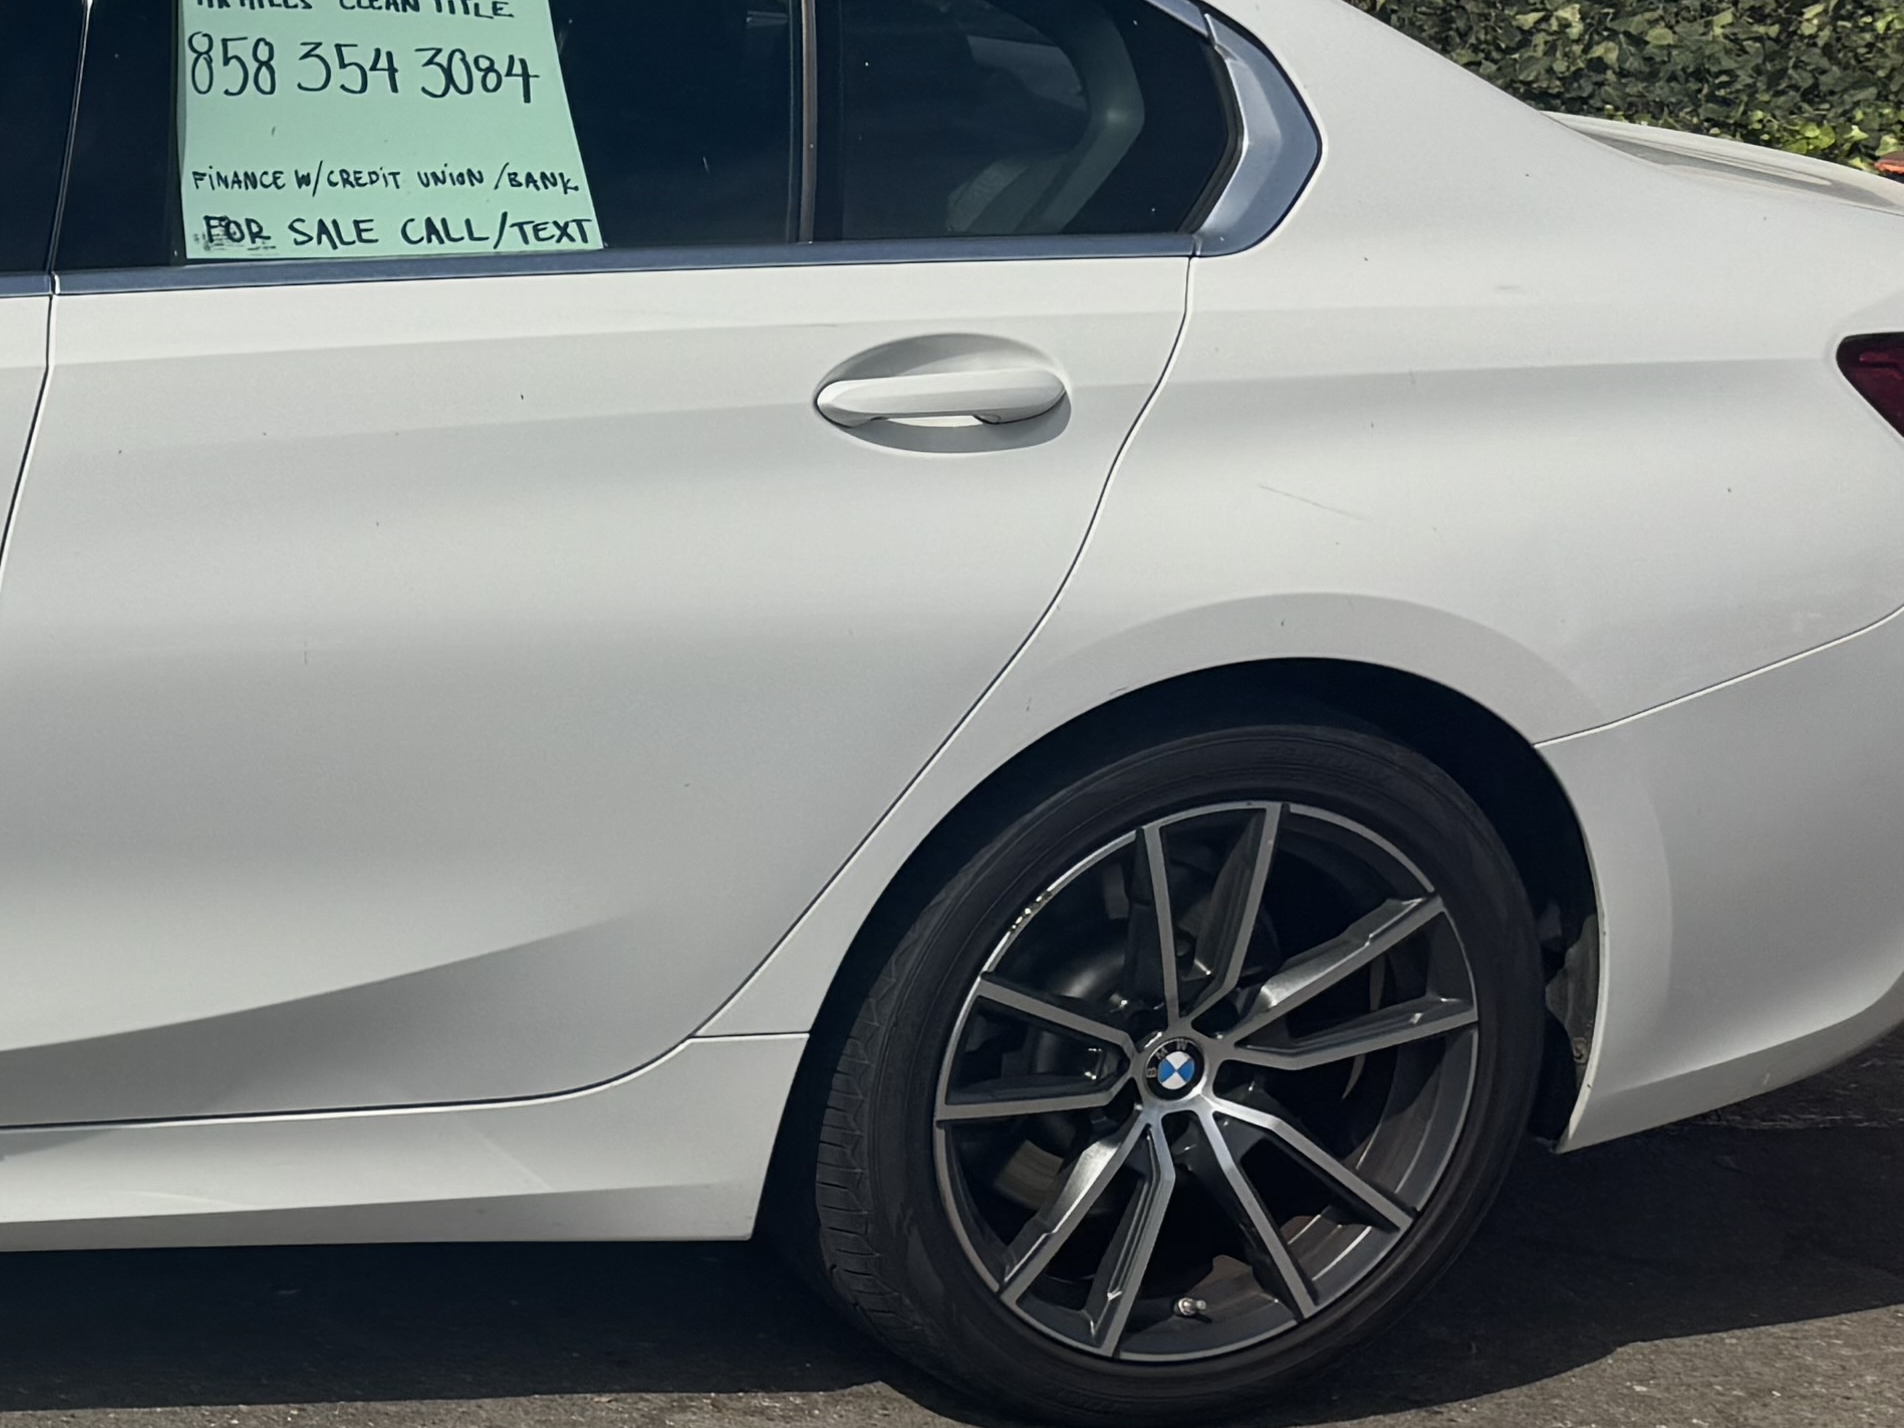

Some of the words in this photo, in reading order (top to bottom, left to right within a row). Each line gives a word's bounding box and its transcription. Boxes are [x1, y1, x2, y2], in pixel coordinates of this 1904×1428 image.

[187, 30, 277, 97] 858
[296, 40, 399, 96] 354
[413, 46, 541, 105] 3084
[202, 215, 271, 246] FOR
[287, 216, 380, 252] SALE
[399, 210, 593, 252] CALL/TEXT
